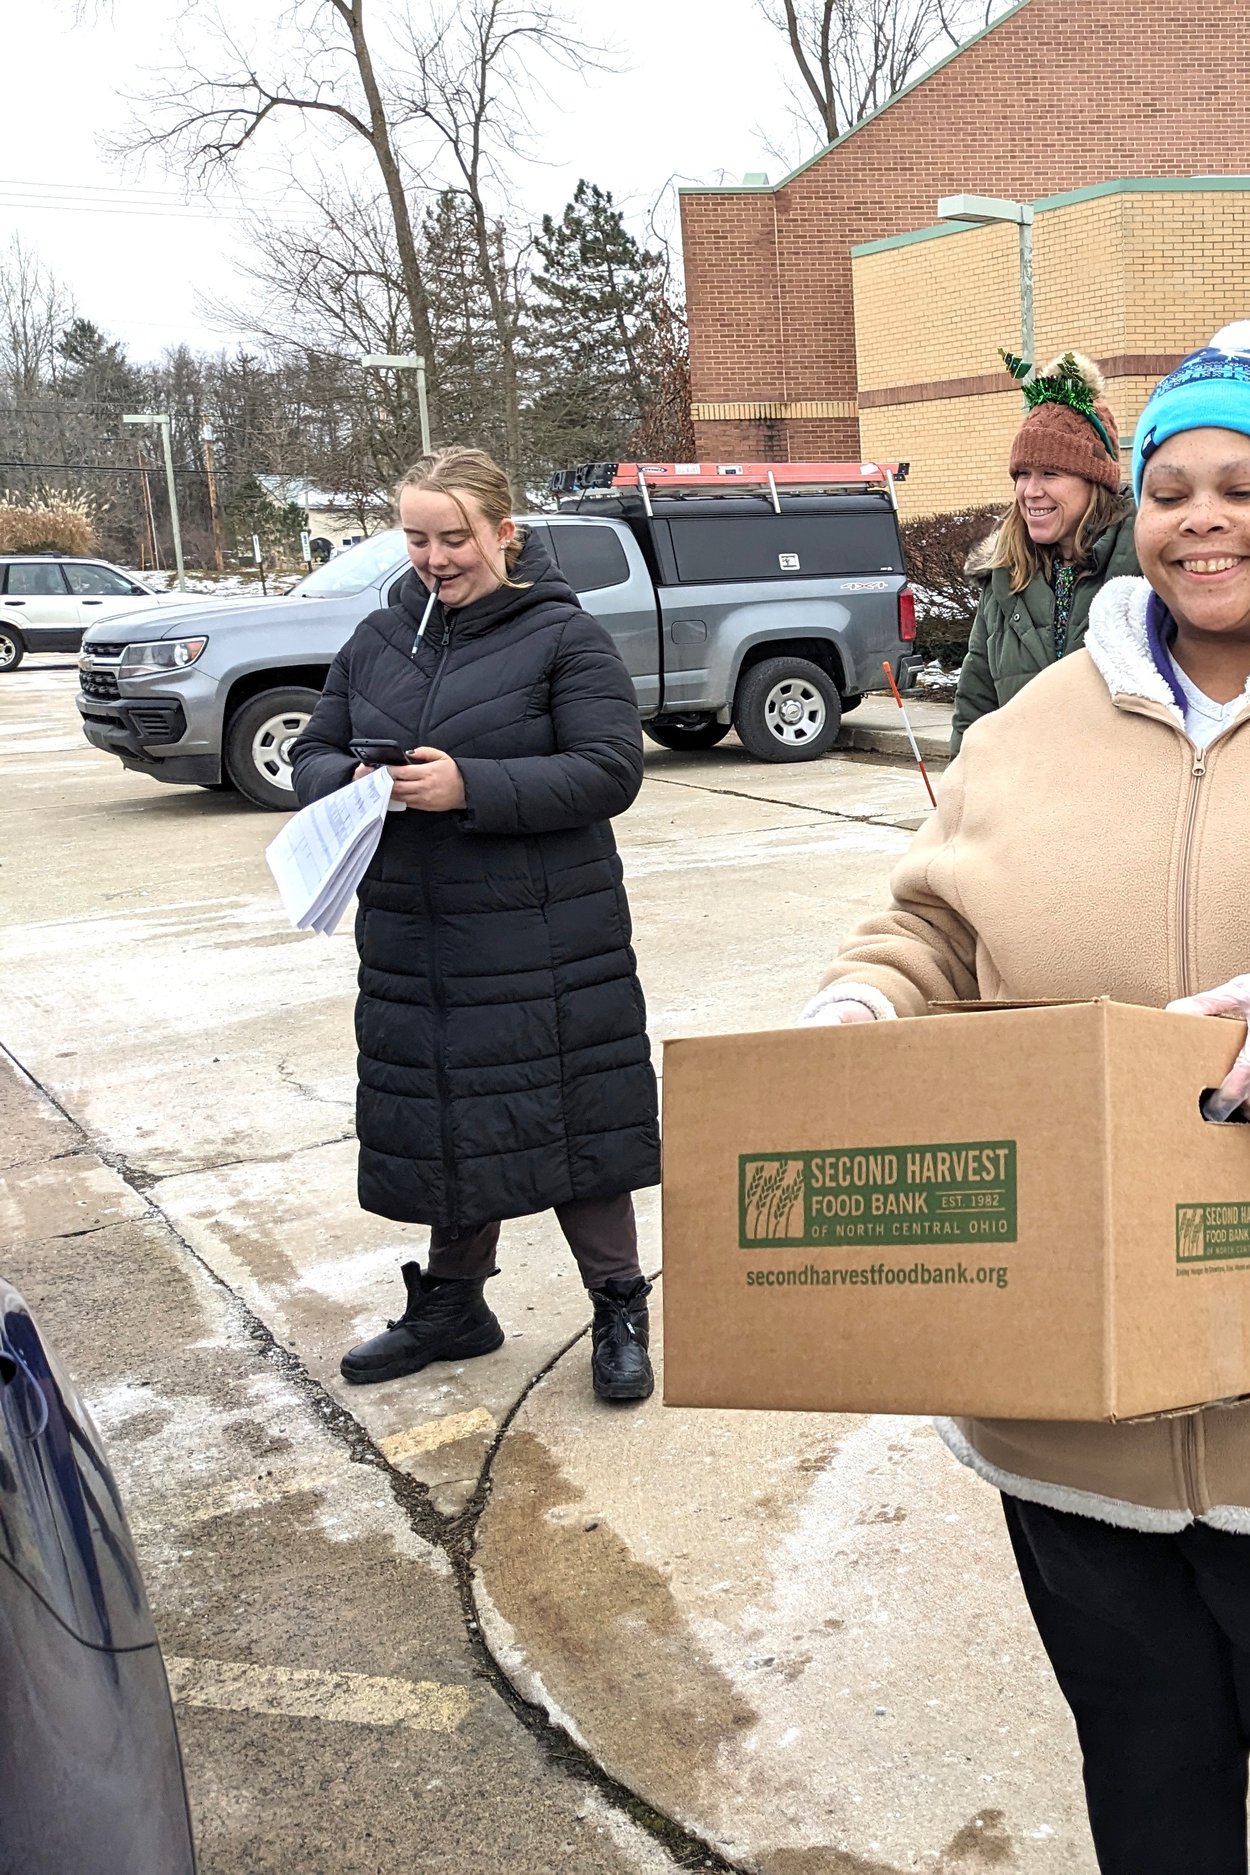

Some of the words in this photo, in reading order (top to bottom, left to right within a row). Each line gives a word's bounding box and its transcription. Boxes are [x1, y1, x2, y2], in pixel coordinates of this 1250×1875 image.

[810, 1154, 898, 1188] SECOND
[906, 1149, 1009, 1184] HARVEST
[812, 1195, 864, 1217] FOOD
[872, 1192, 928, 1215] BANK
[942, 1196, 966, 1209] EST.
[971, 1194, 1000, 1207] 1982
[1206, 1206, 1239, 1225] SECOND
[812, 1225, 828, 1238] OF
[836, 1222, 884, 1236] NORTH
[892, 1221, 960, 1235] CENTRAL
[969, 1220, 1008, 1234] OHIO
[1206, 1229, 1227, 1243] FOOD
[1229, 1228, 1250, 1242] BANK
[746, 1262, 1008, 1288] secondharvestfoodbank.org
